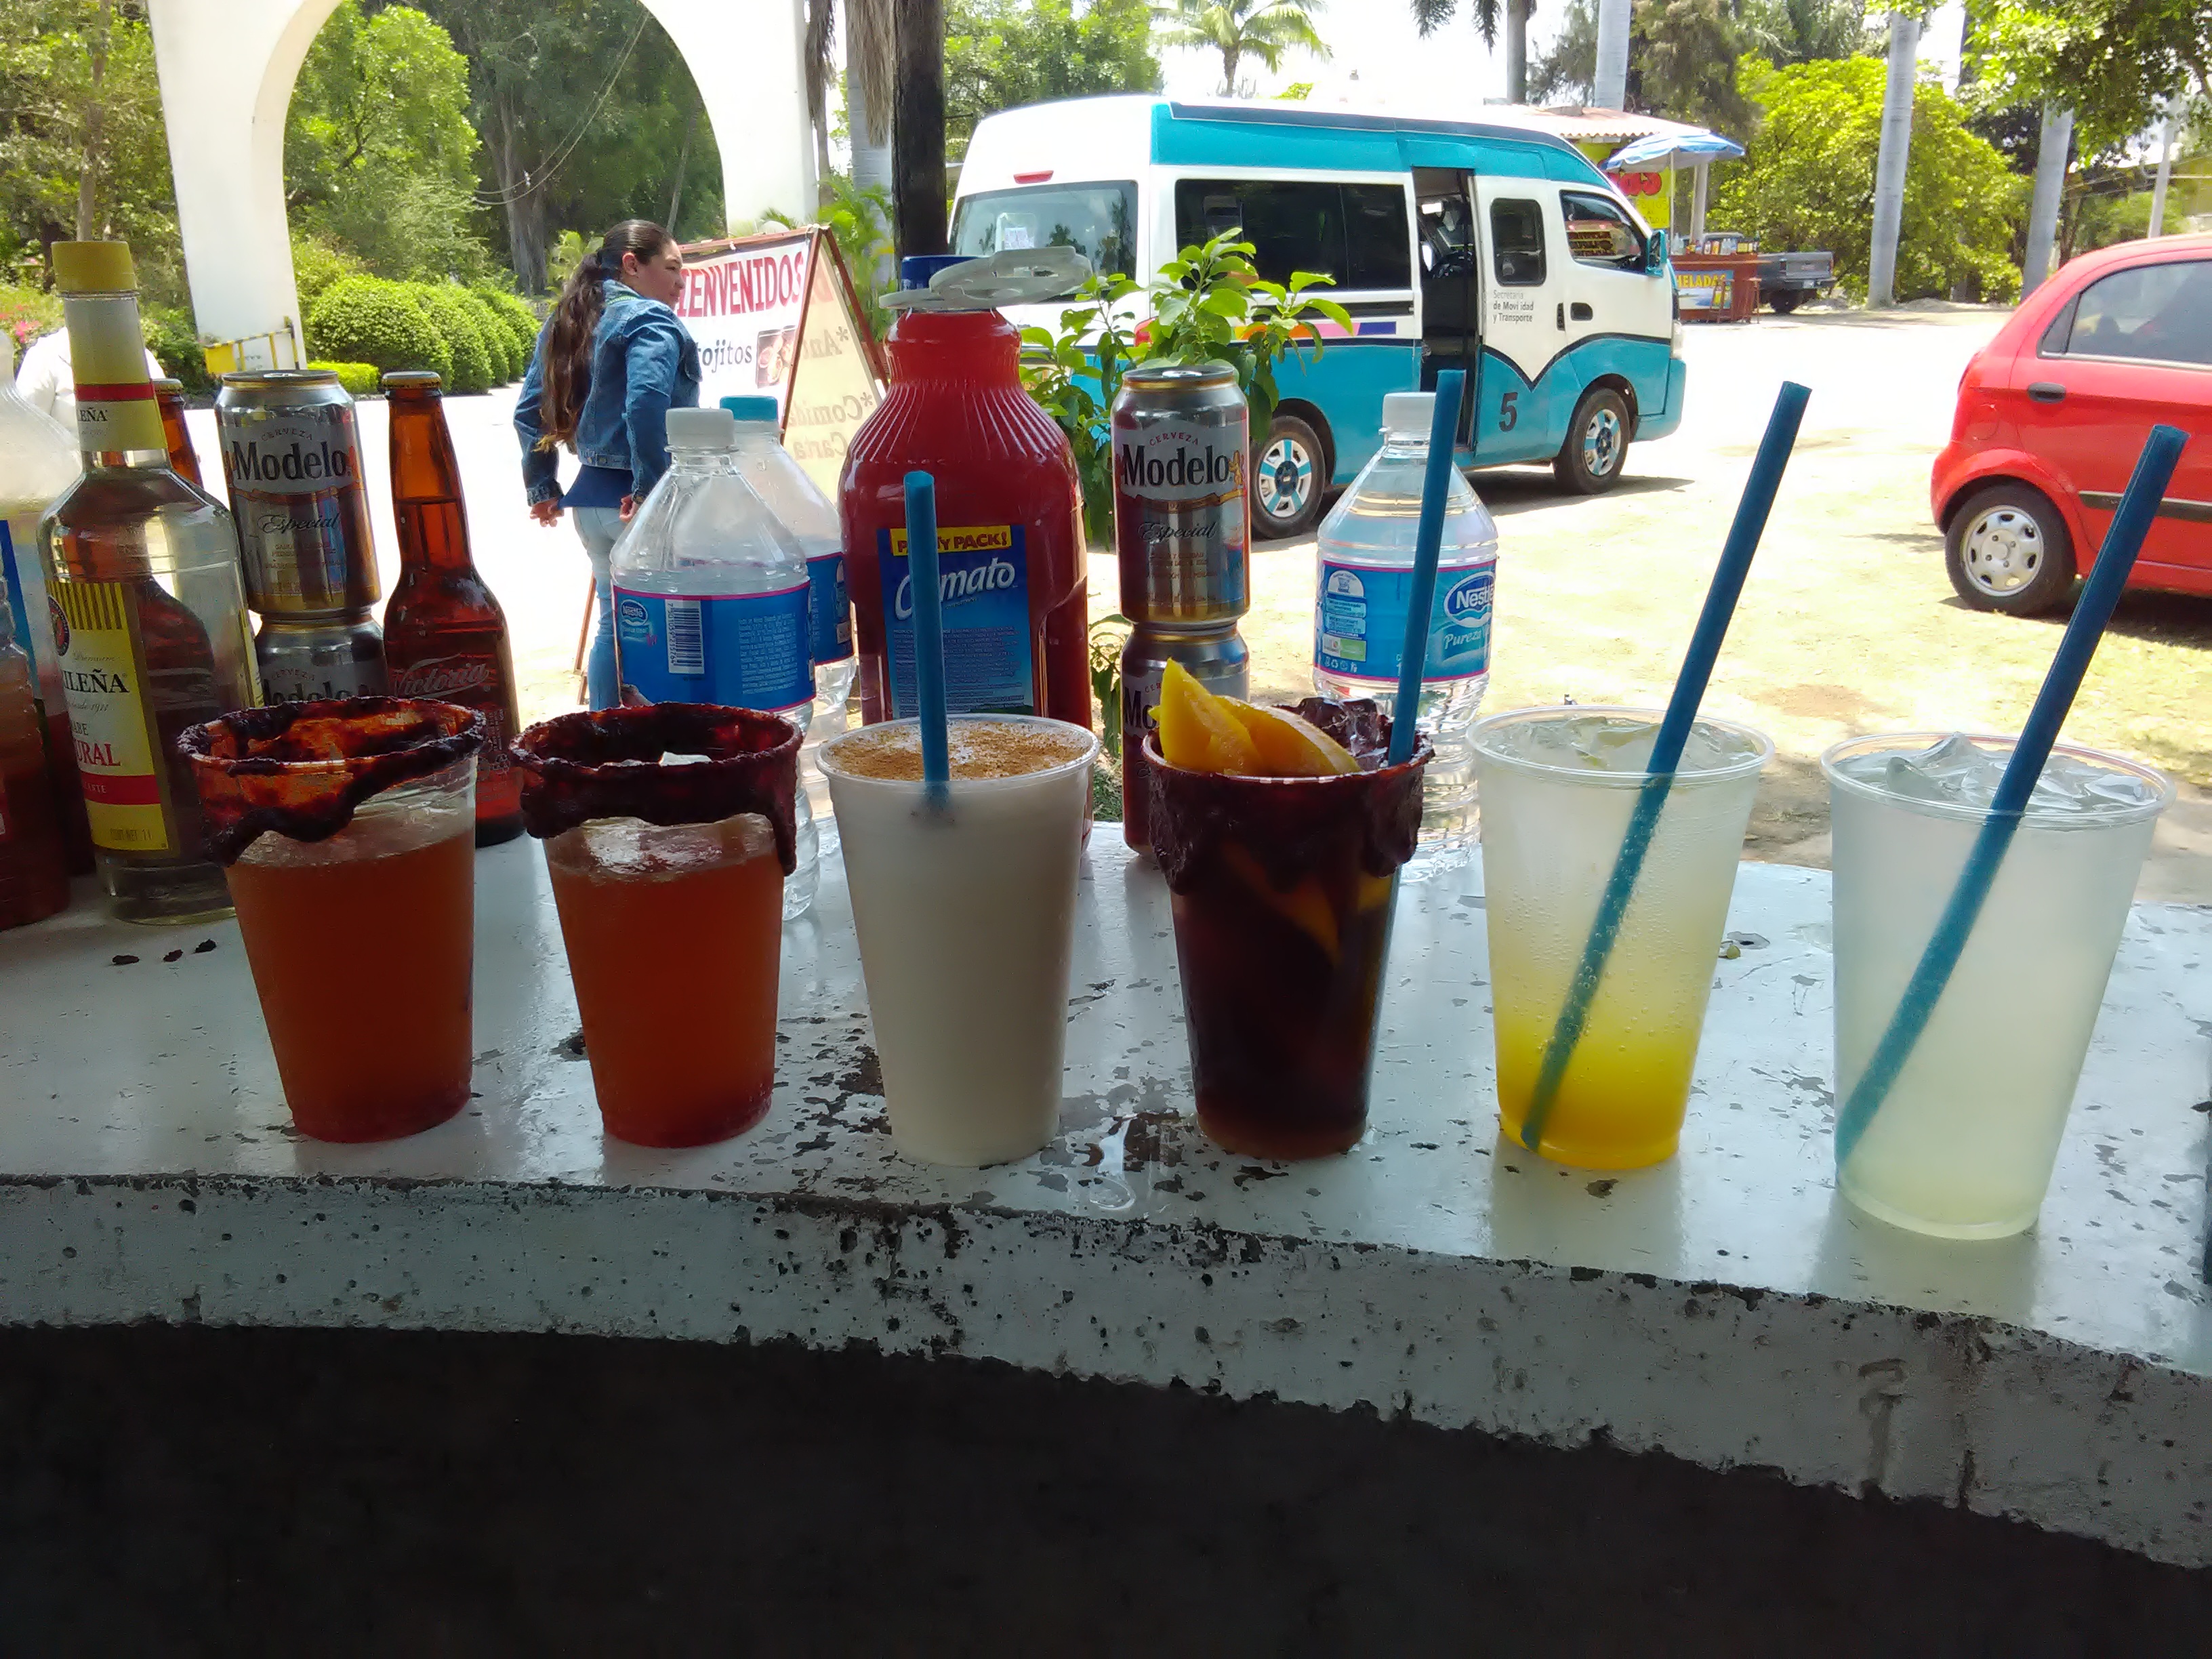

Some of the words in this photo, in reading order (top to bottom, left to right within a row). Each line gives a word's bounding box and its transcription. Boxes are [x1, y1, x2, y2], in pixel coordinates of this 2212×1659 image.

[1493, 300, 1501, 310] de
[1502, 301, 1534, 311] Moviidad
[1493, 314, 1497, 324] y
[1498, 312, 1533, 325] Transporte
[1499, 392, 1518, 432] 5
[262, 428, 313, 441] CERVEZA
[1149, 432, 1199, 447] CERVEZA
[232, 441, 347, 481] Modelo
[1122, 444, 1230, 487] Modelo
[258, 512, 342, 534] Especial
[1138, 521, 1218, 542] Especial
[954, 531, 1008, 550] PACK!
[895, 556, 1015, 621] Cmato
[392, 662, 489, 697] Victoria
